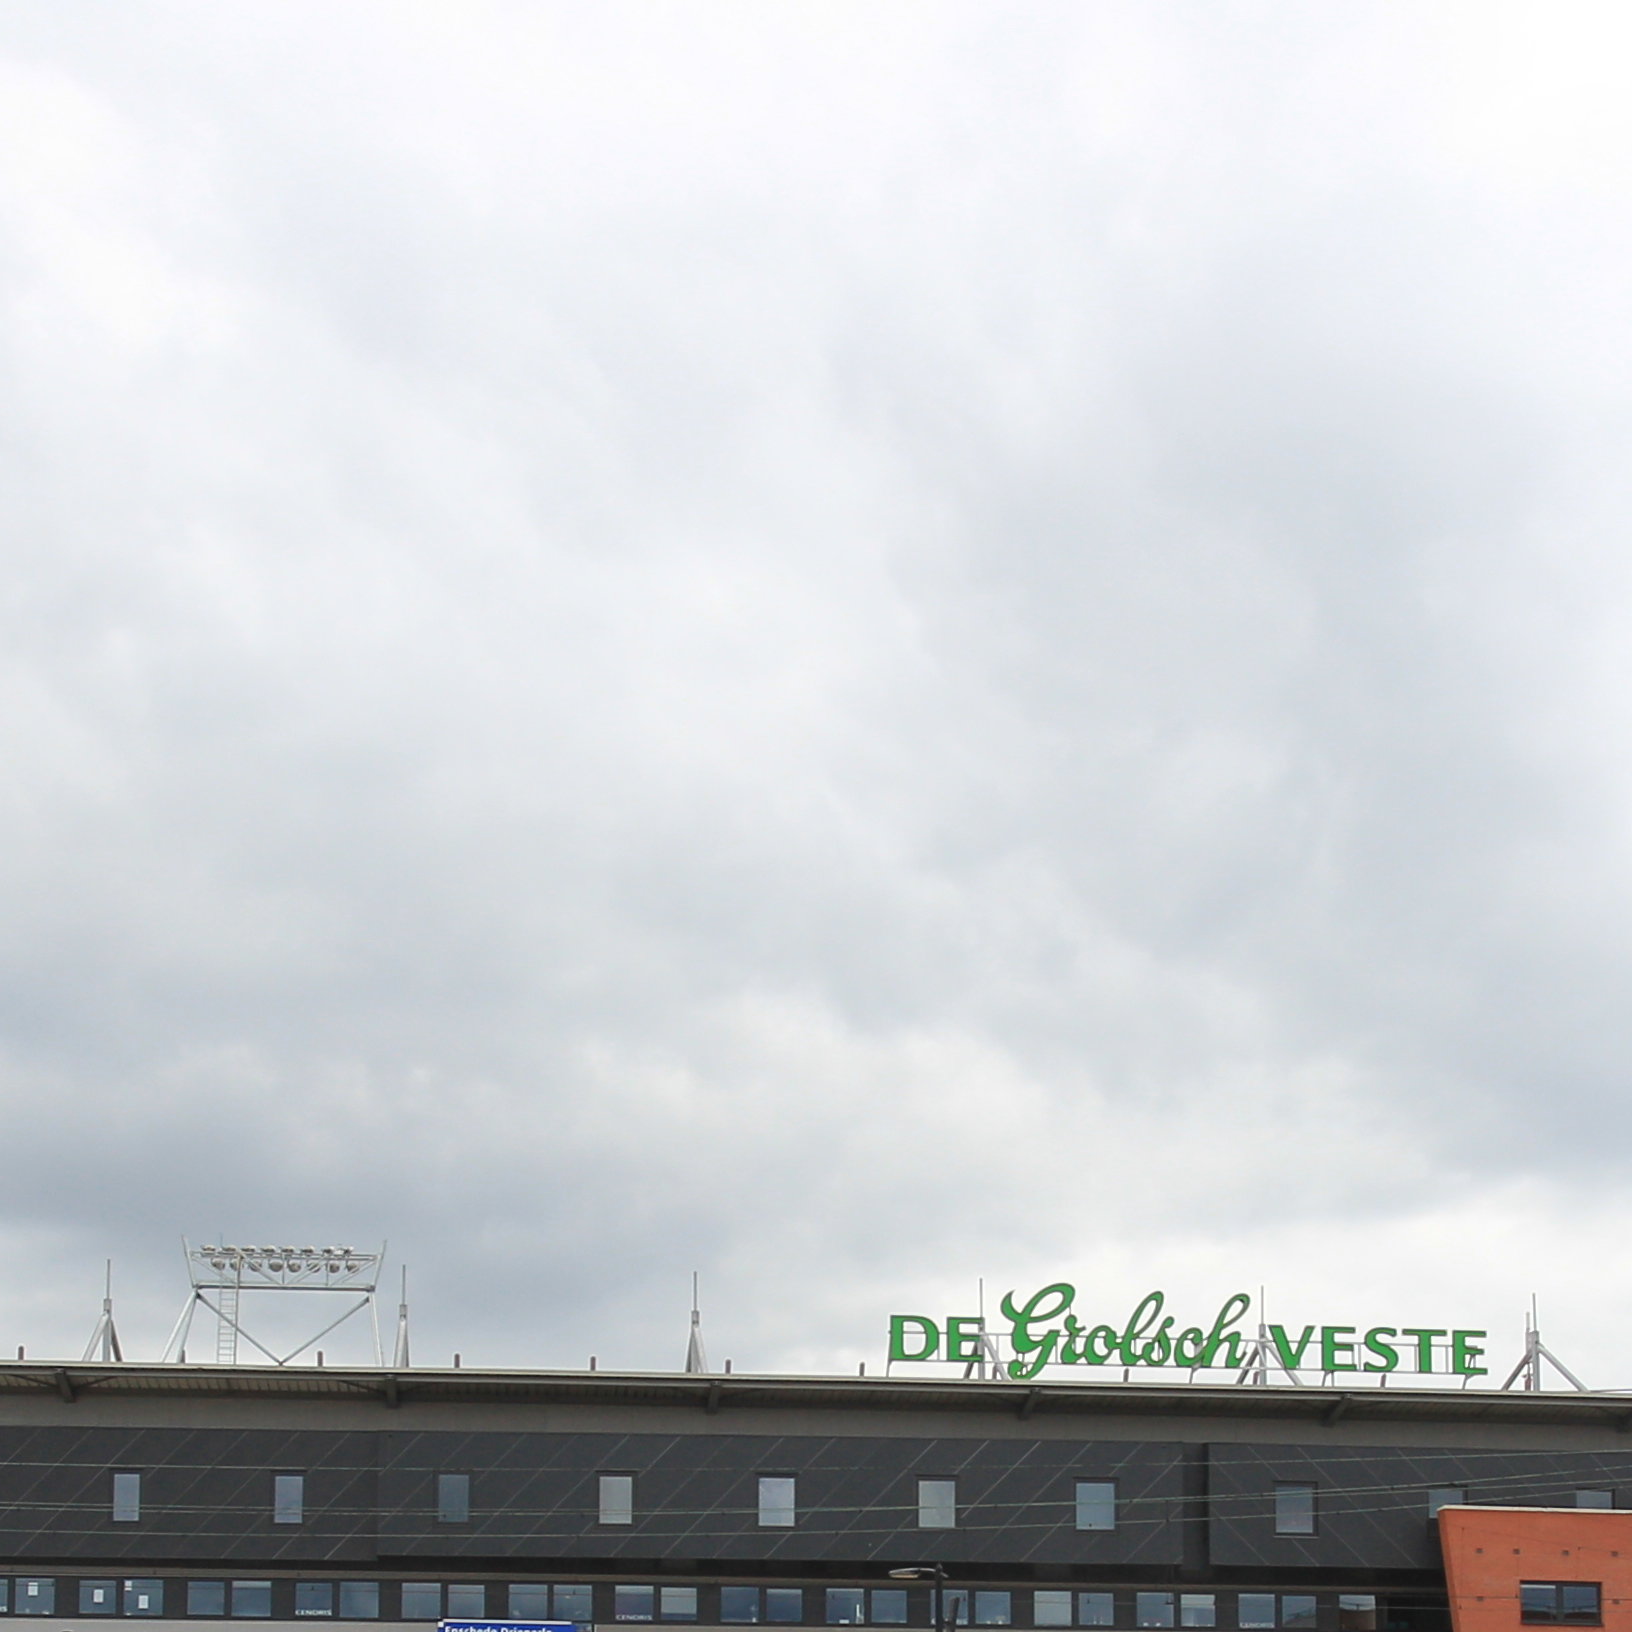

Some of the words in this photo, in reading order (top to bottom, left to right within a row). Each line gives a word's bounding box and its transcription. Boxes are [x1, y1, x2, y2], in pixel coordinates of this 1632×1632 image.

[889, 1315, 985, 1362] DE
[1001, 1282, 1251, 1379] Grolsch
[1269, 1324, 1488, 1375] VESTE
